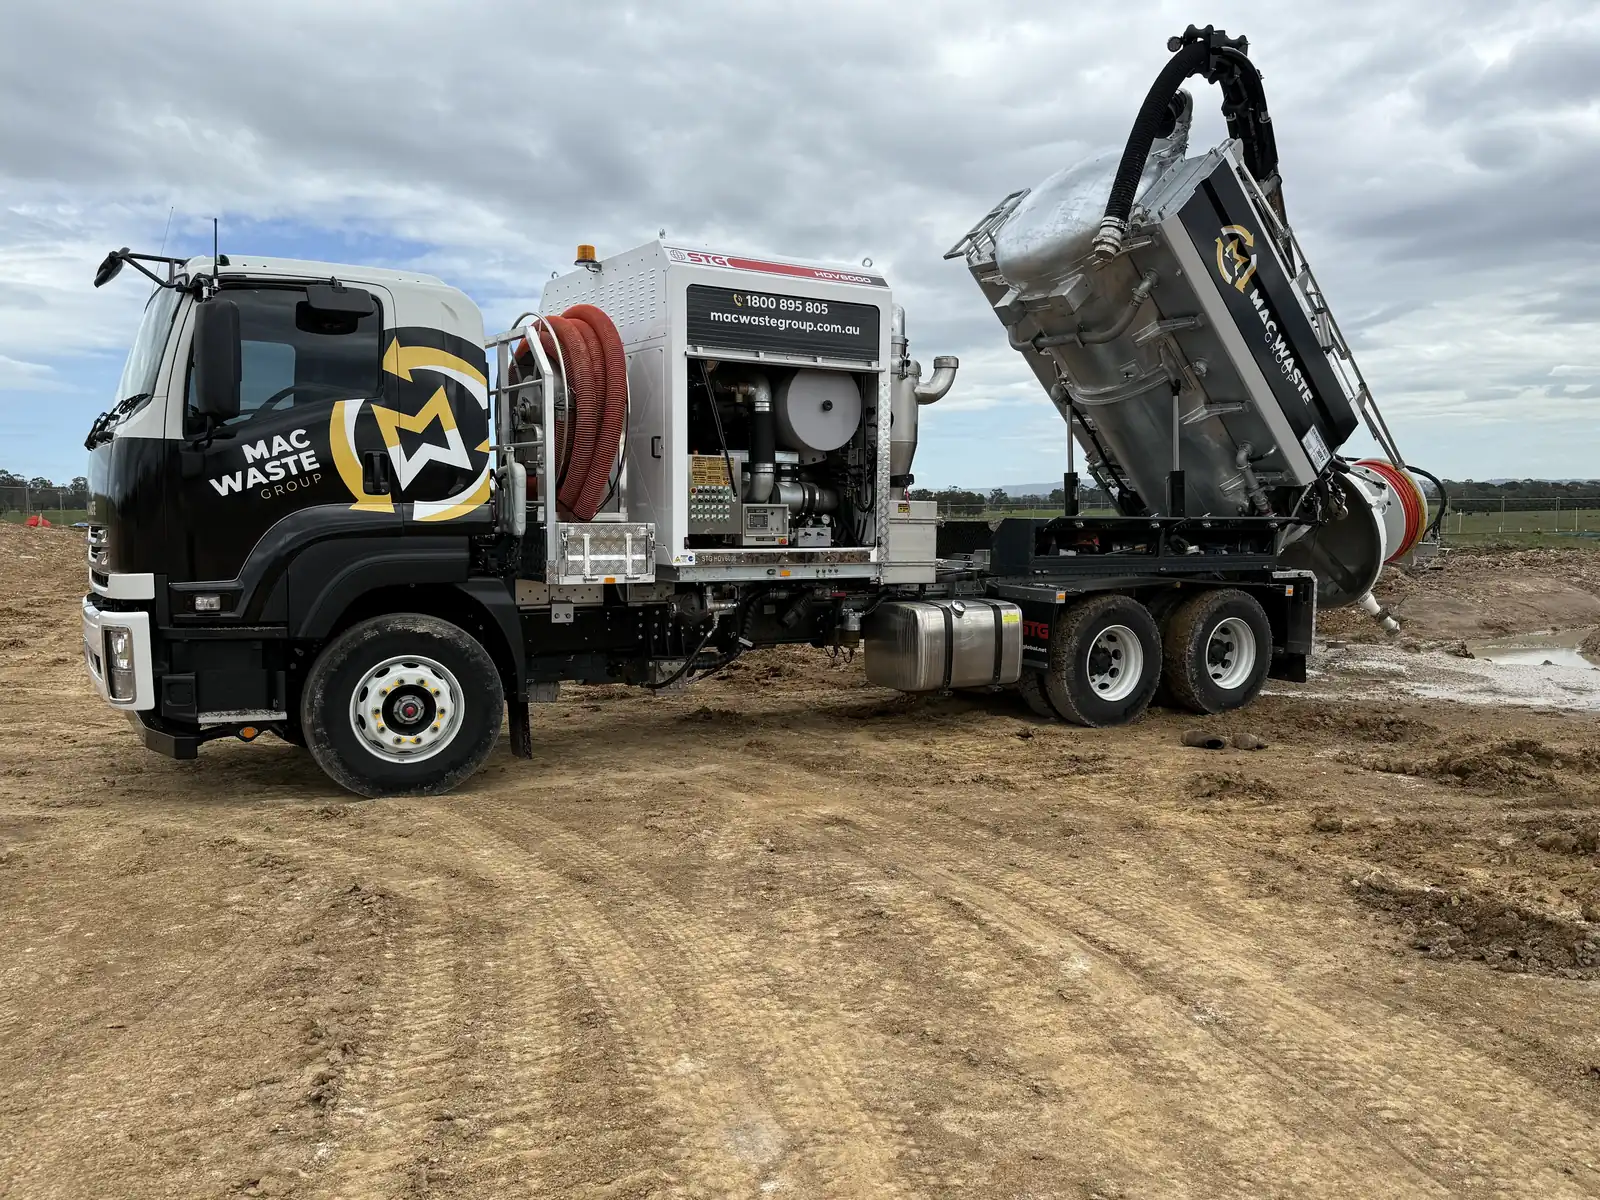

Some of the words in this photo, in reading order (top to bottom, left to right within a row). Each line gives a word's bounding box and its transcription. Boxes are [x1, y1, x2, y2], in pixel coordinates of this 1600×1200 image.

[687, 252, 727, 267] STG
[814, 271, 872, 284] HDV6000
[745, 295, 776, 309] 1800
[779, 298, 802, 312] 895
[805, 301, 829, 315] 805
[710, 311, 860, 335] macwastegroup.com.au
[1249, 288, 1277, 334] MAC
[1274, 333, 1314, 405] WASTE
[1264, 331, 1294, 382] GROUP
[241, 428, 311, 464] MAC
[208, 449, 320, 497] WASTE
[260, 473, 322, 499] GROUP
